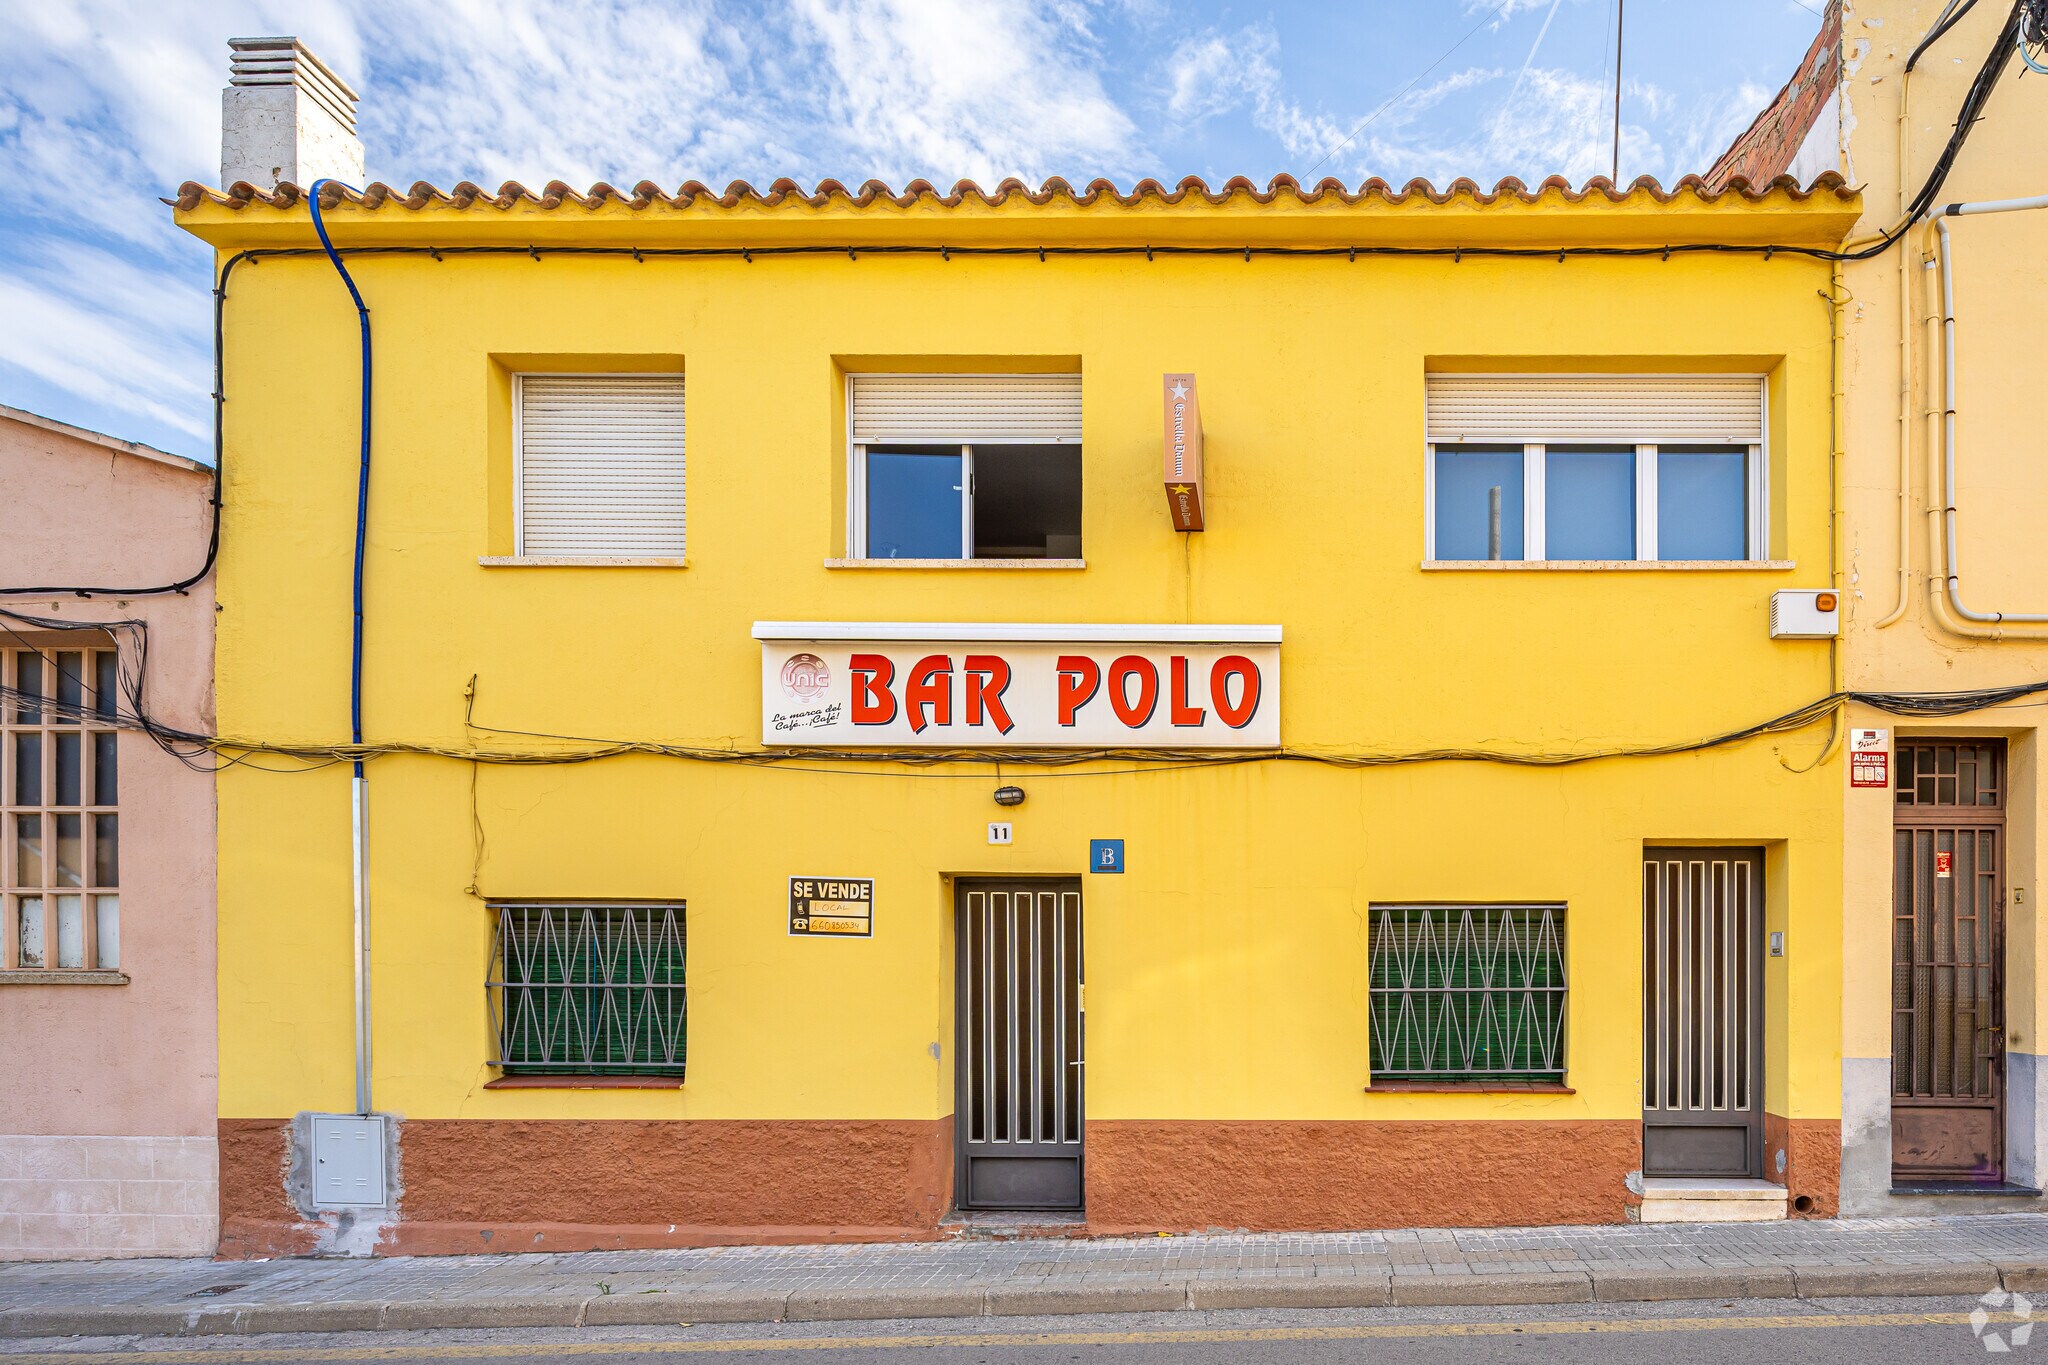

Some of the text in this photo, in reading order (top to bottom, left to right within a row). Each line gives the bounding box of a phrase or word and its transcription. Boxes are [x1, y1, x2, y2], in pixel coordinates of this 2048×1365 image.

[1174, 402, 1185, 477] Estrella Damm
[848, 653, 1262, 736] BAR POLO
[772, 702, 841, 722] La marca del
[1853, 753, 1885, 762] Alarma
[993, 827, 1007, 840] 11
[1101, 847, 1115, 865] B
[793, 881, 870, 900] SE VENDE
[814, 902, 849, 912] LOCAL
